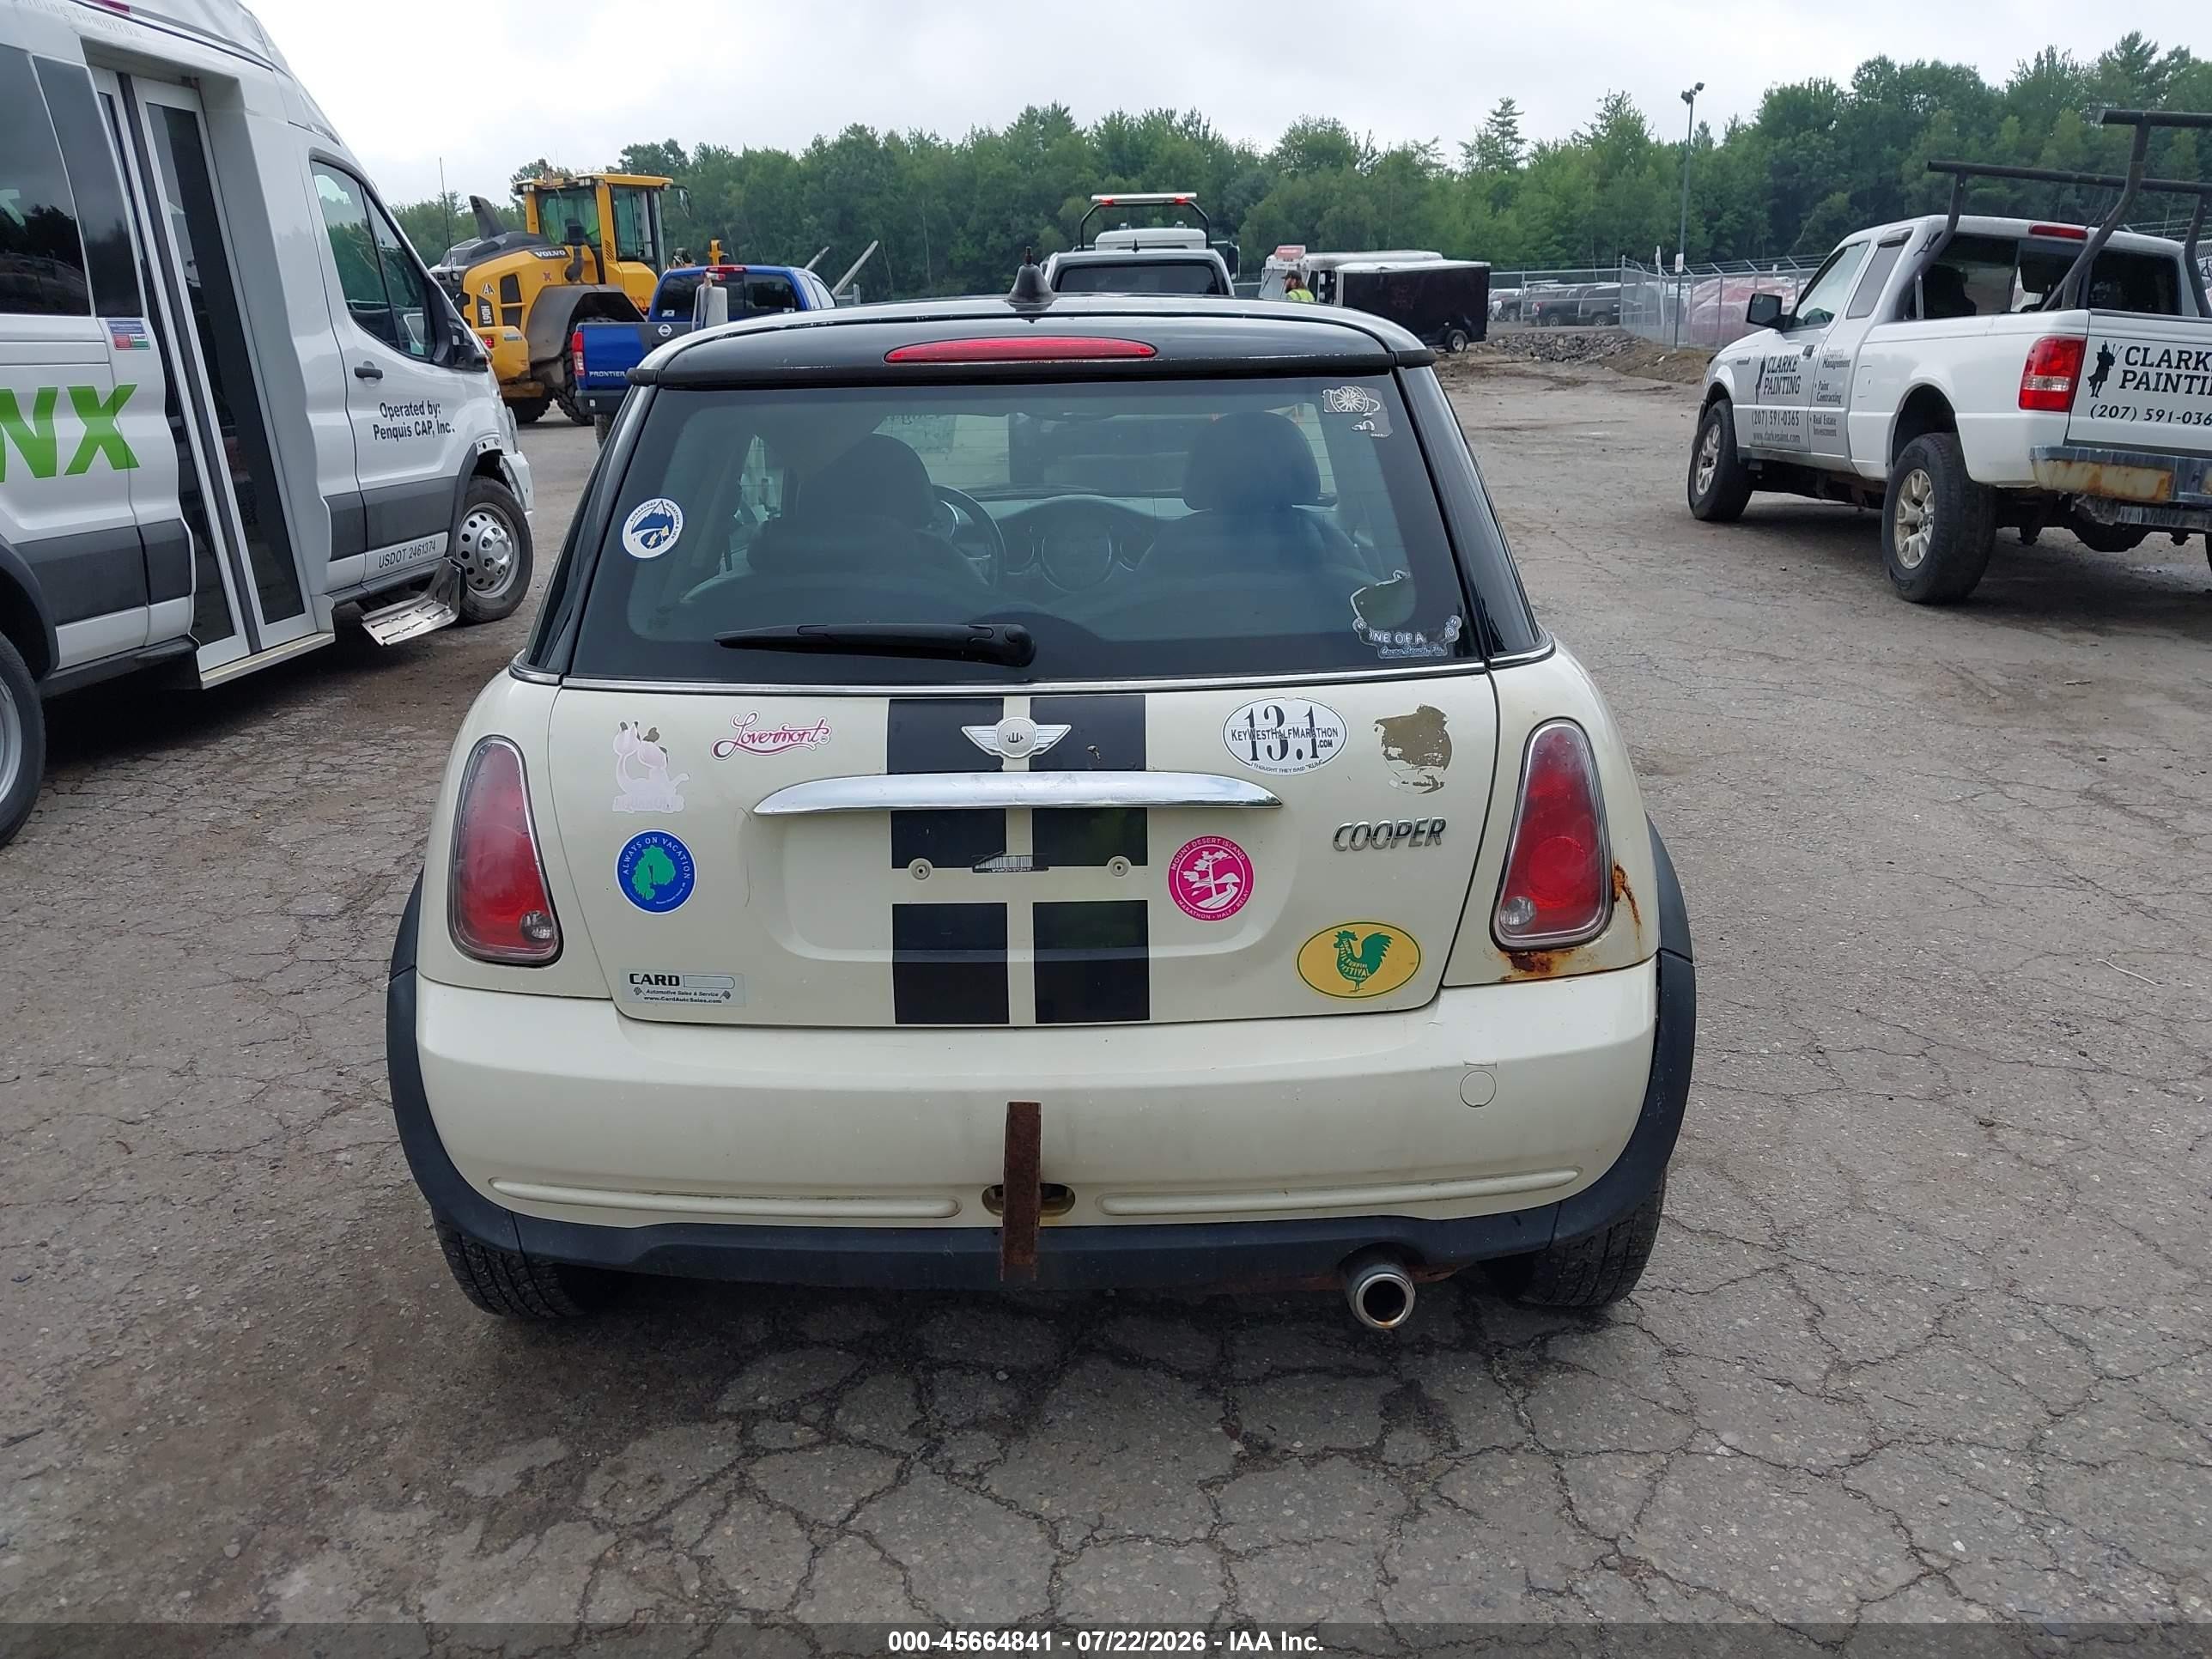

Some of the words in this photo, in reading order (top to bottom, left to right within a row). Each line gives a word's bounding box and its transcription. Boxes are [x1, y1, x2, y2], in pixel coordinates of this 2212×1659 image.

[534, 249, 566, 258] VOLVO
[480, 305, 492, 324] L90H
[1766, 354, 1800, 374] CLARKE
[2125, 345, 2212, 373] CLARK
[1763, 374, 1802, 395] PAINTING
[2118, 369, 2212, 397] PAINTI
[379, 400, 426, 422] Operated
[427, 399, 441, 418] by:
[1751, 410, 1767, 428] (207)
[1769, 410, 1800, 427] 591-0365
[2090, 404, 2137, 422] (207)
[373, 422, 412, 442] Penquis
[414, 421, 435, 439] CAP,
[436, 419, 455, 434] Inc.
[379, 548, 407, 569] USDOT
[408, 540, 436, 560] 2461374
[712, 712, 830, 758] Lovermont
[1244, 705, 1320, 761] 13.1
[1254, 763, 1279, 773] THOUGHT
[1333, 816, 1447, 852] COOPER
[623, 841, 642, 875] ALWAYS
[645, 836, 658, 845] ON
[662, 838, 690, 879] VACATION
[1170, 846, 1191, 871] MOUNT
[1192, 837, 1221, 848] DESERT
[1222, 840, 1246, 860] ISLAND
[1177, 899, 1211, 920] MARATHON
[1236, 890, 1249, 908] RELAY
[629, 973, 680, 987] CARD
